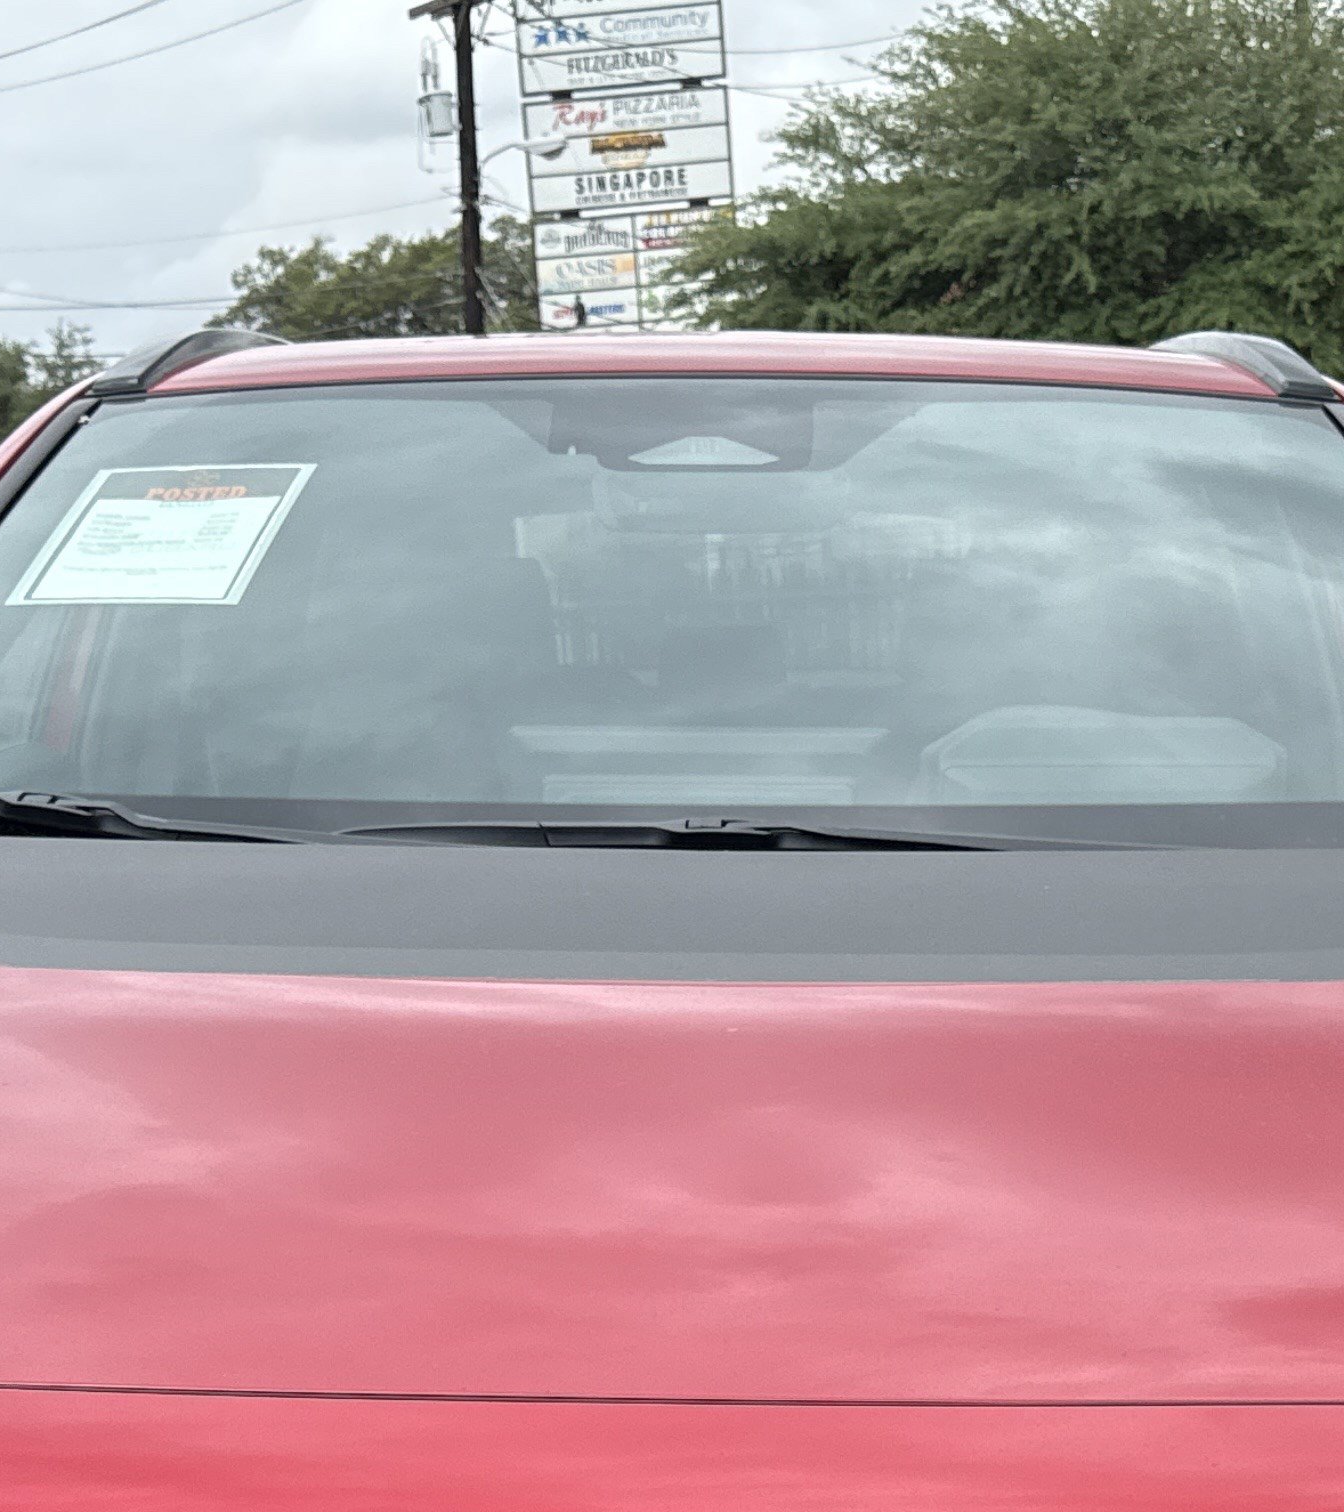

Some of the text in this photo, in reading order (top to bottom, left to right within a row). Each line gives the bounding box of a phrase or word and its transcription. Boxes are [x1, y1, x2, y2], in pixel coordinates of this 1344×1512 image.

[599, 10, 711, 34] Community
[573, 168, 689, 196] SINGAPORE
[145, 486, 248, 502] POSTED
